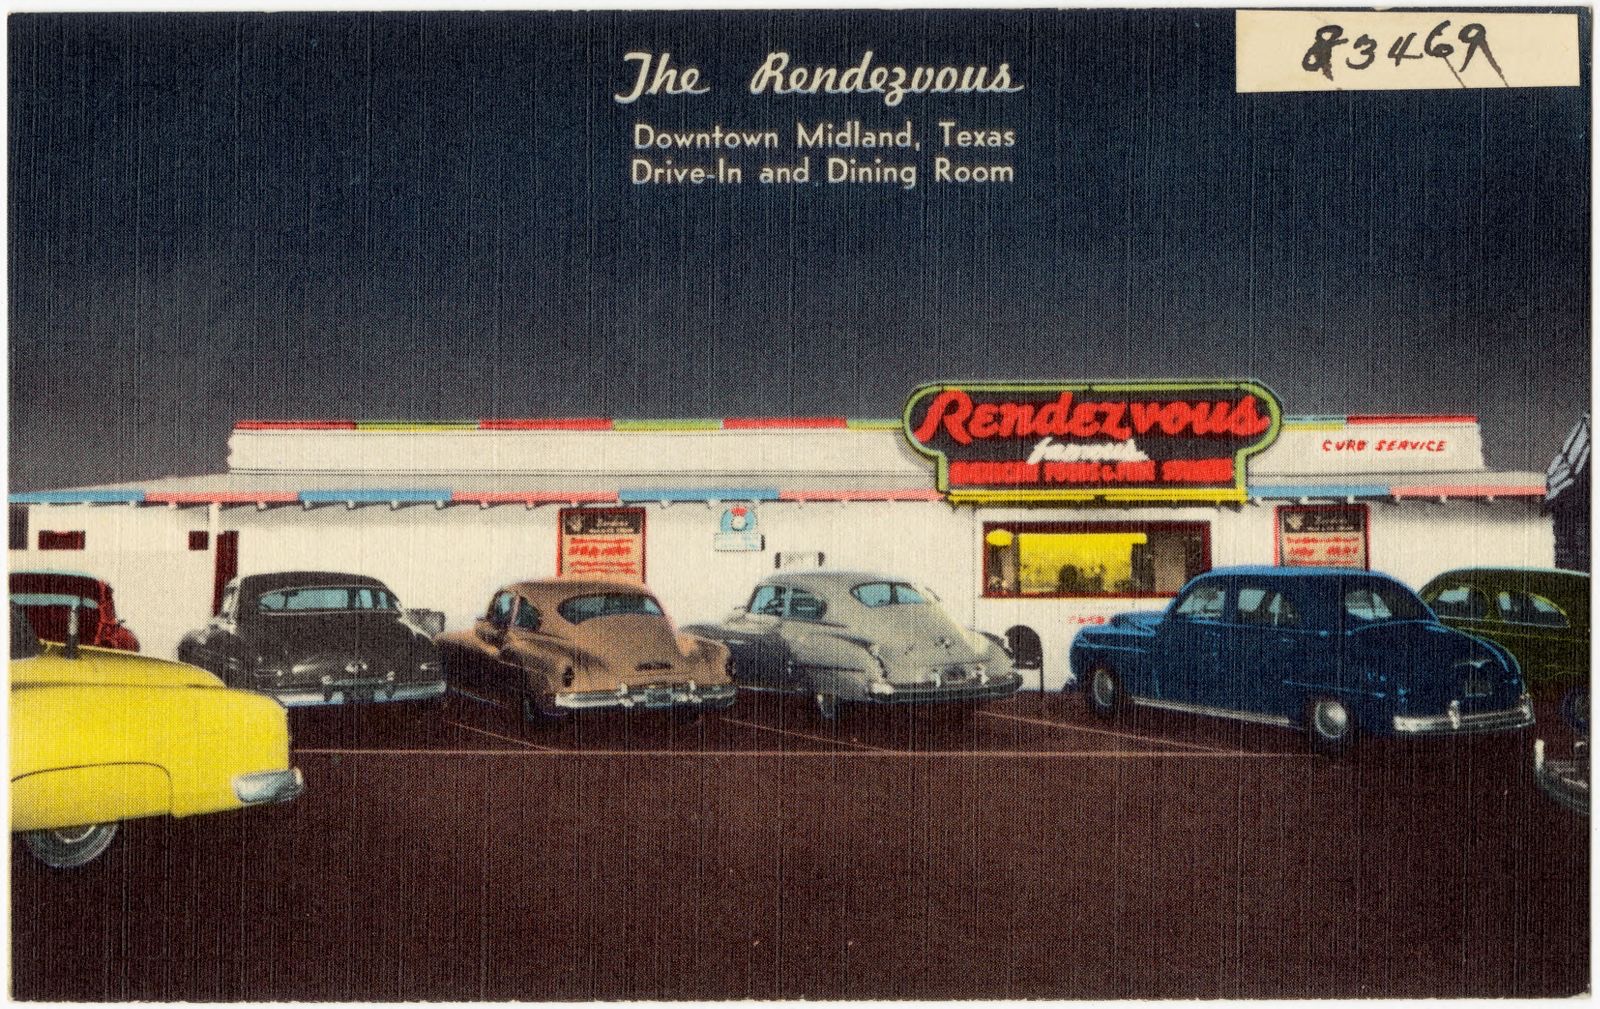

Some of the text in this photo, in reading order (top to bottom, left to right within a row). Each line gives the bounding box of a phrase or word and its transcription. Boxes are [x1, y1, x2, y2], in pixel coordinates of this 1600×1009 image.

[1302, 20, 1509, 88] 83469
[914, 390, 1271, 444] Rendezvous
[1375, 439, 1447, 453] SERVICE
